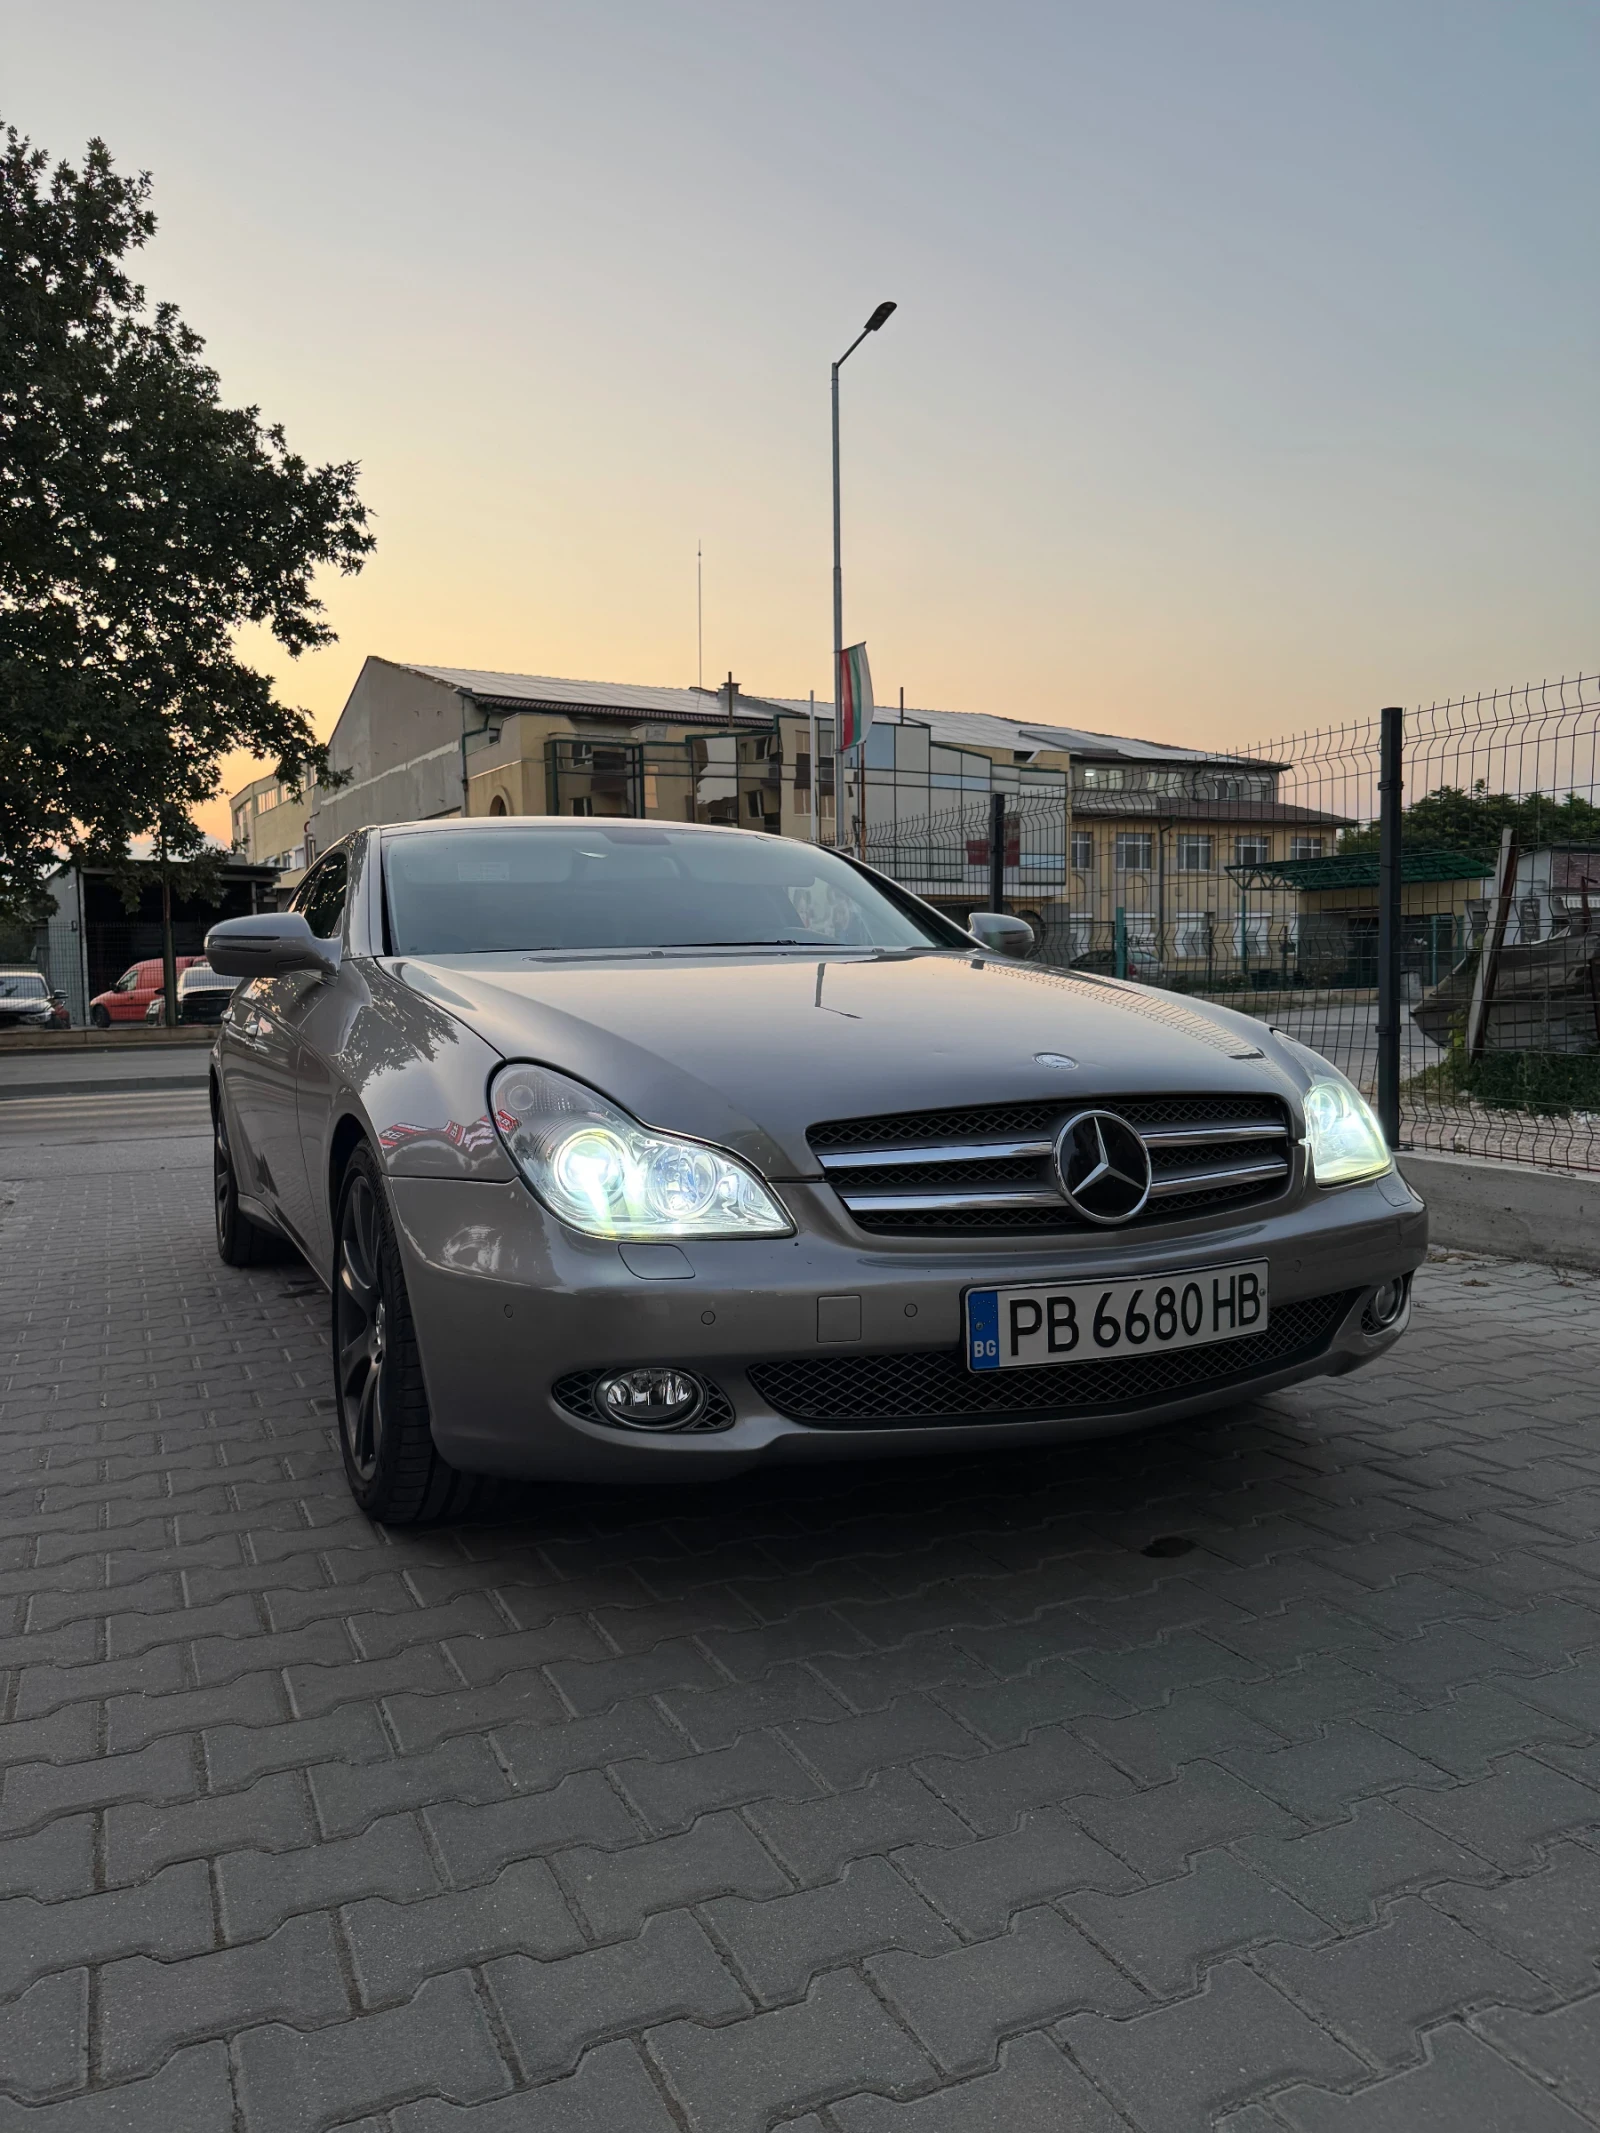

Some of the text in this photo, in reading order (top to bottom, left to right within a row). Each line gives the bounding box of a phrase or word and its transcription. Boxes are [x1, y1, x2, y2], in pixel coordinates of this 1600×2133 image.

[1009, 1273, 1260, 1356] PB 6680 HB
[974, 1340, 996, 1357] BG
